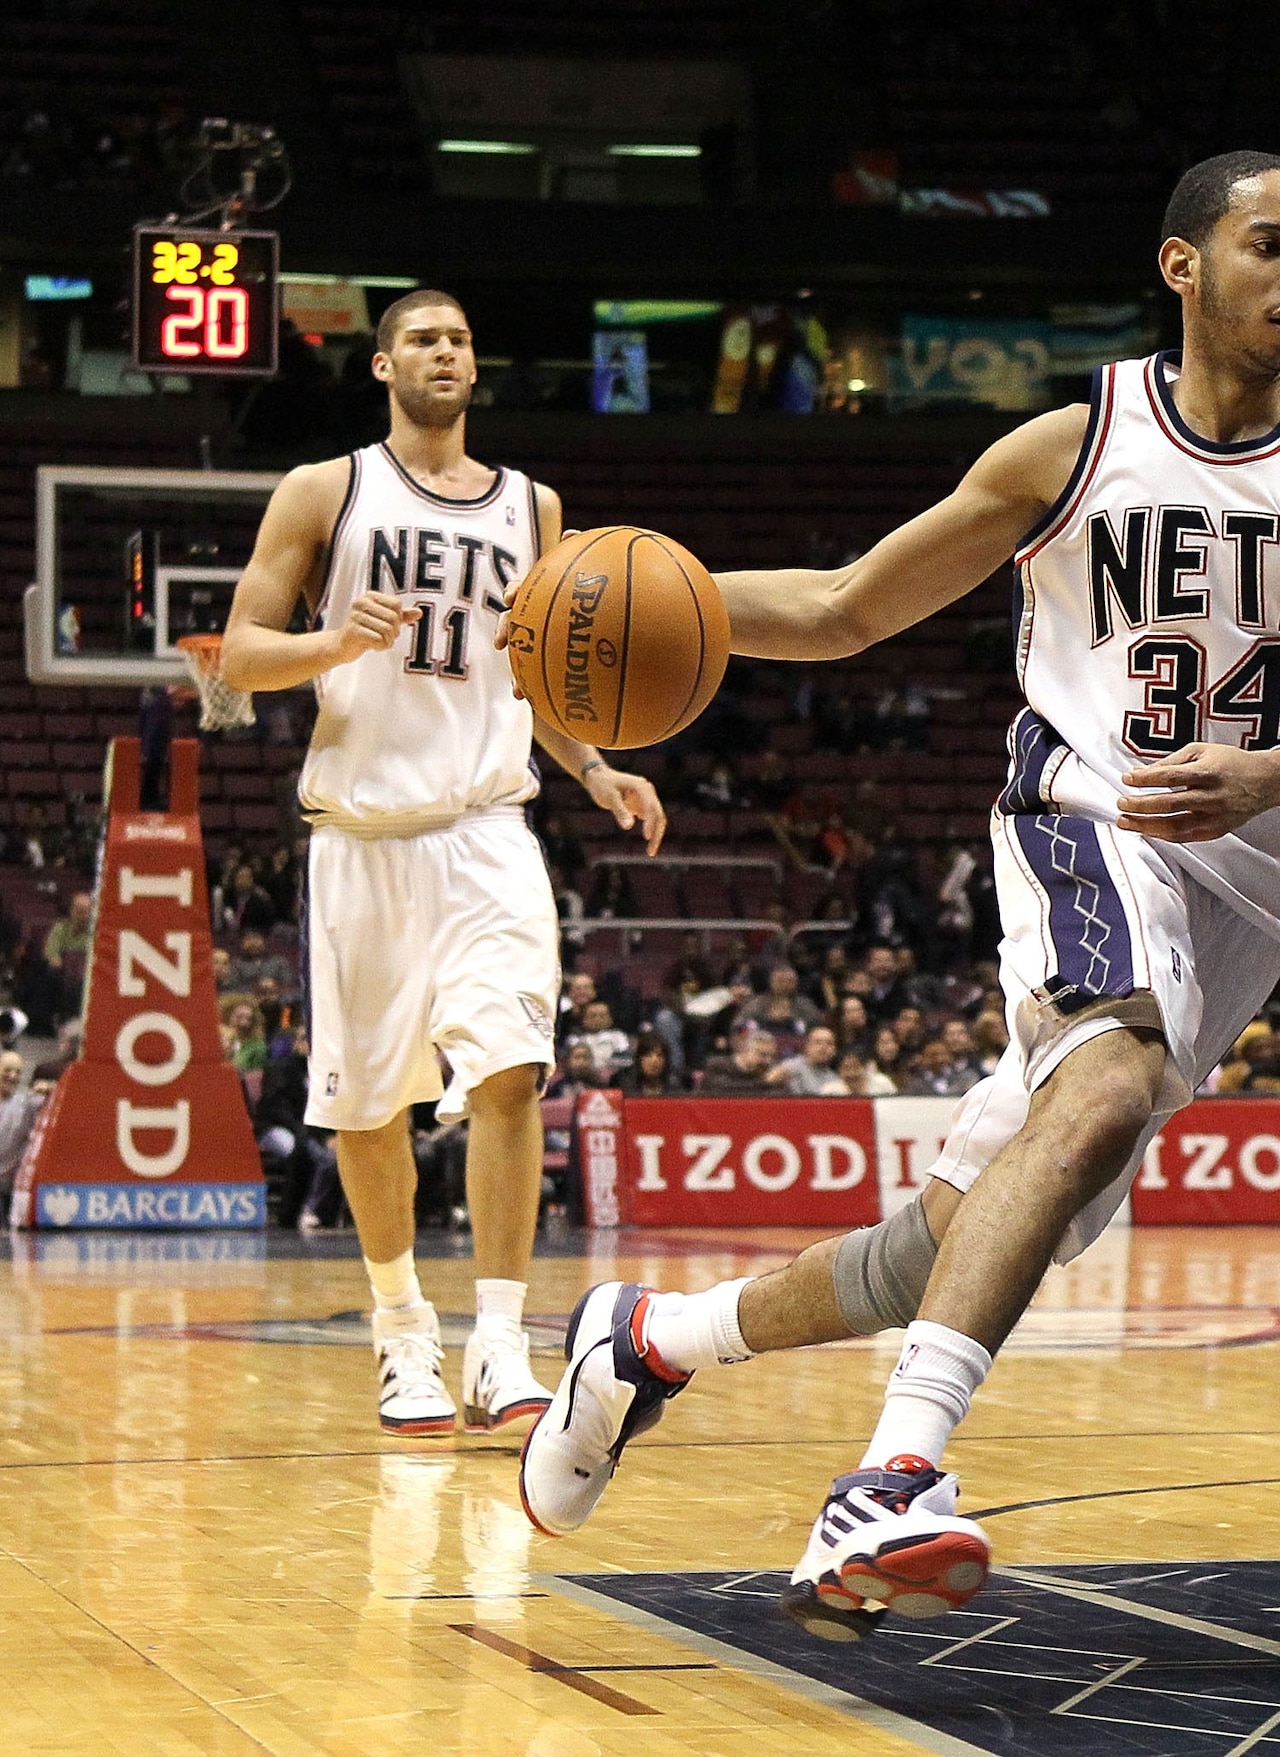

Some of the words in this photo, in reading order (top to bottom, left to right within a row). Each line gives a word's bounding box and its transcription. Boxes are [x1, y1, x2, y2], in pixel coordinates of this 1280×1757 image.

[152, 241, 239, 286] 32.2
[161, 285, 249, 358] 20
[367, 526, 518, 618] NETS
[403, 600, 473, 681] 11
[565, 571, 609, 722] SPALDING
[116, 867, 193, 1178] IZOD
[635, 1133, 868, 1193] IZOD
[86, 1190, 257, 1222] BARCLAYS
